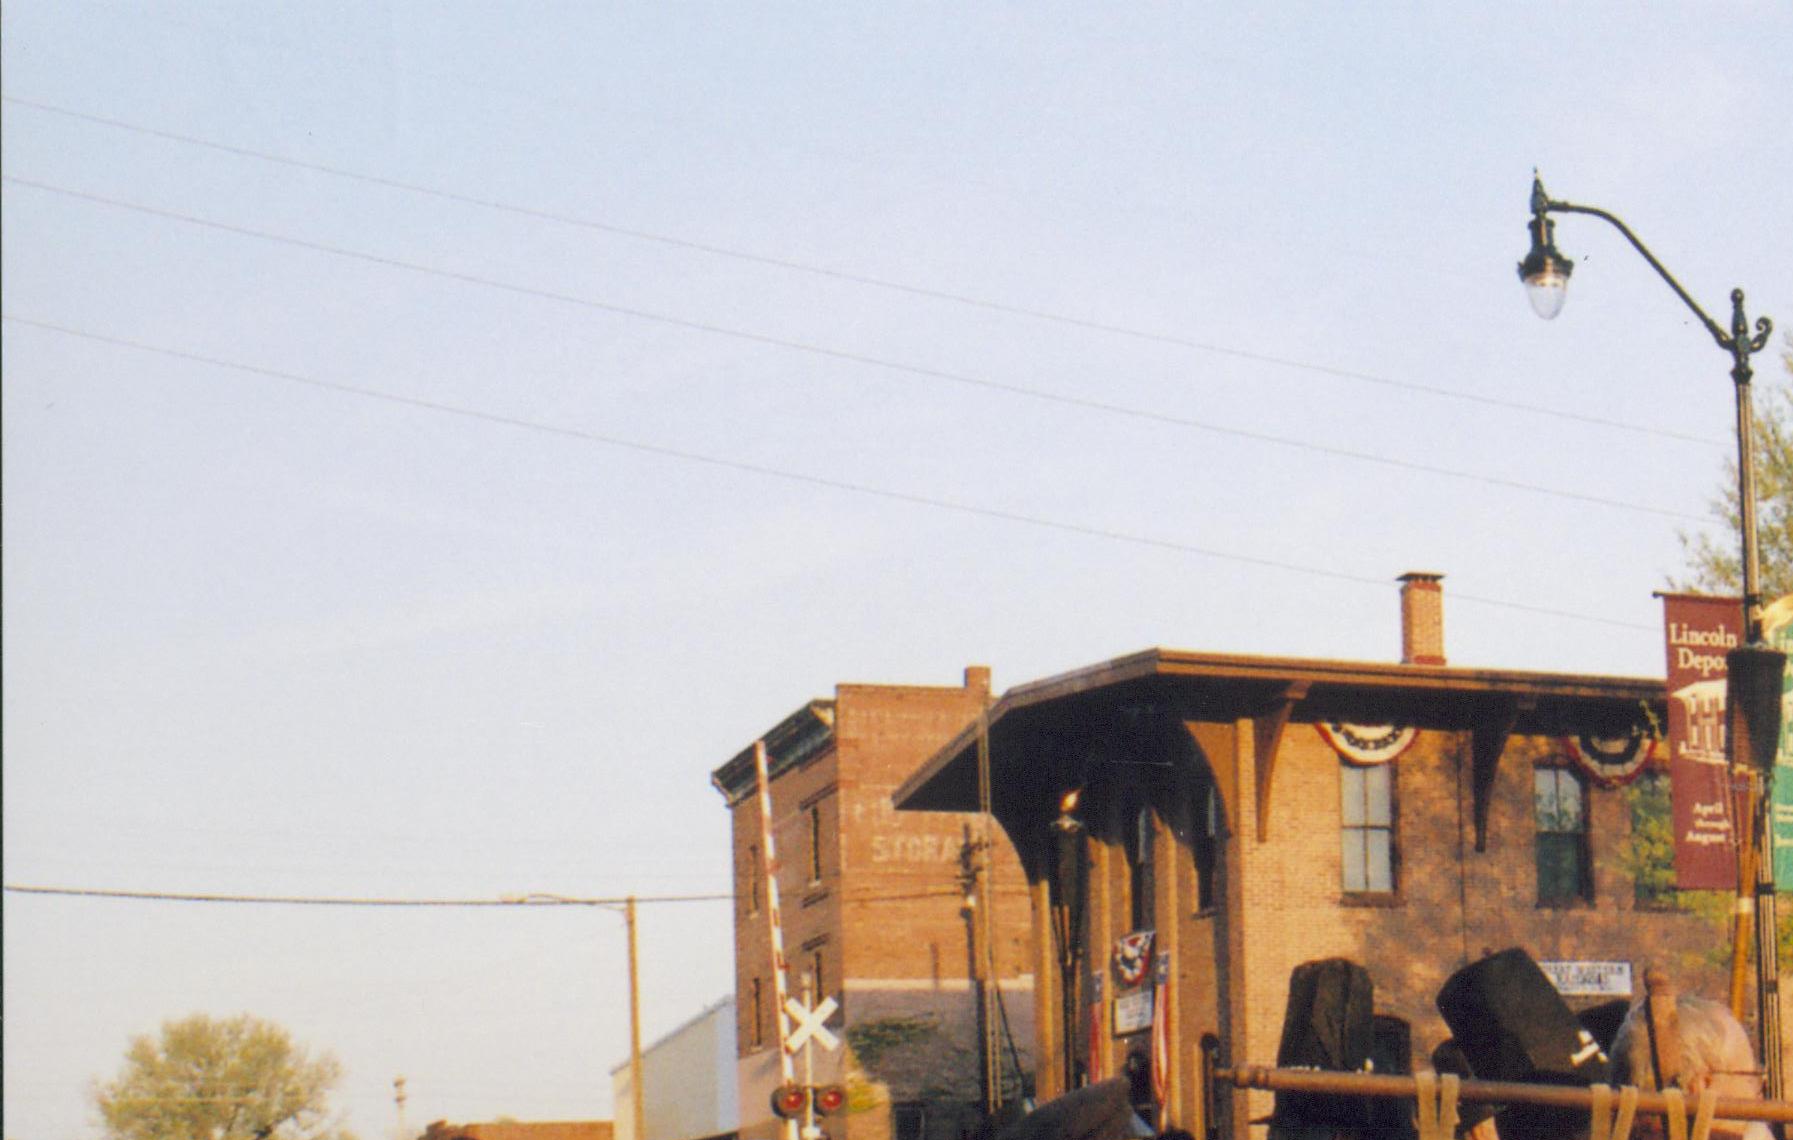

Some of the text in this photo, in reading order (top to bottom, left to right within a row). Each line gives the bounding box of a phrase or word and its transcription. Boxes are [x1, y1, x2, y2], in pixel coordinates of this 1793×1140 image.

[1669, 623, 1738, 649] Lincoln
[1677, 647, 1729, 678] Depo
[871, 834, 965, 864] STORA
